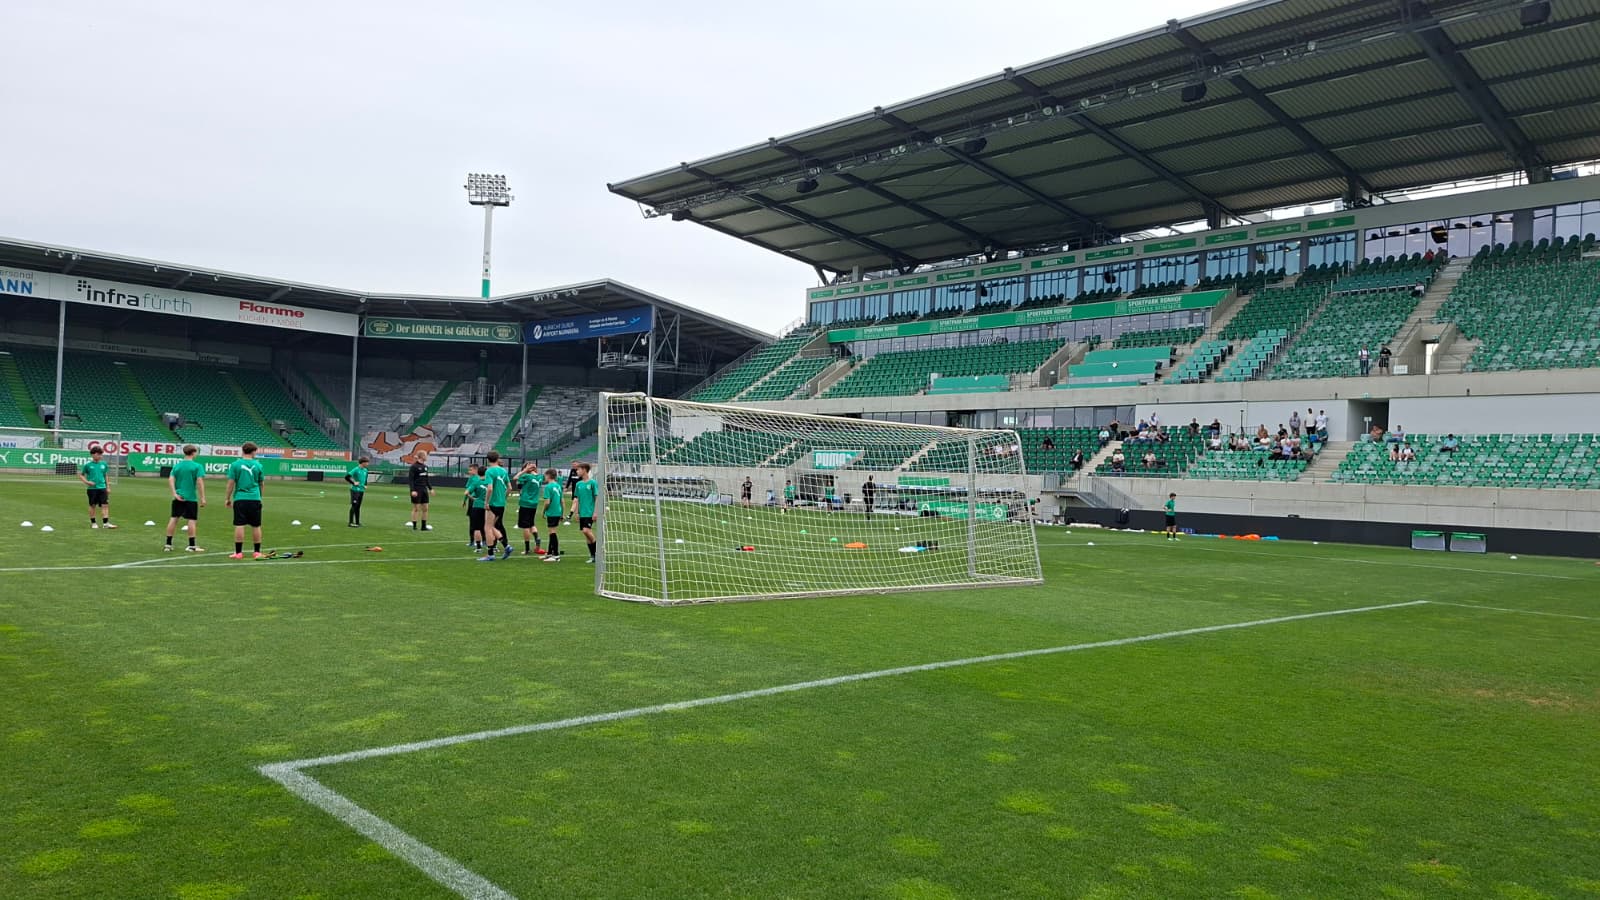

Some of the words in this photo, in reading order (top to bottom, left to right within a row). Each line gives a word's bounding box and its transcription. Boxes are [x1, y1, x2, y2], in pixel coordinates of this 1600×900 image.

[86, 285, 139, 307] infra
[143, 293, 192, 313] fürth
[239, 301, 305, 318] Flamme
[396, 324, 410, 333] Der
[444, 325, 454, 336] ist
[456, 325, 489, 337] GRÜNER!
[23, 453, 47, 465] CSL
